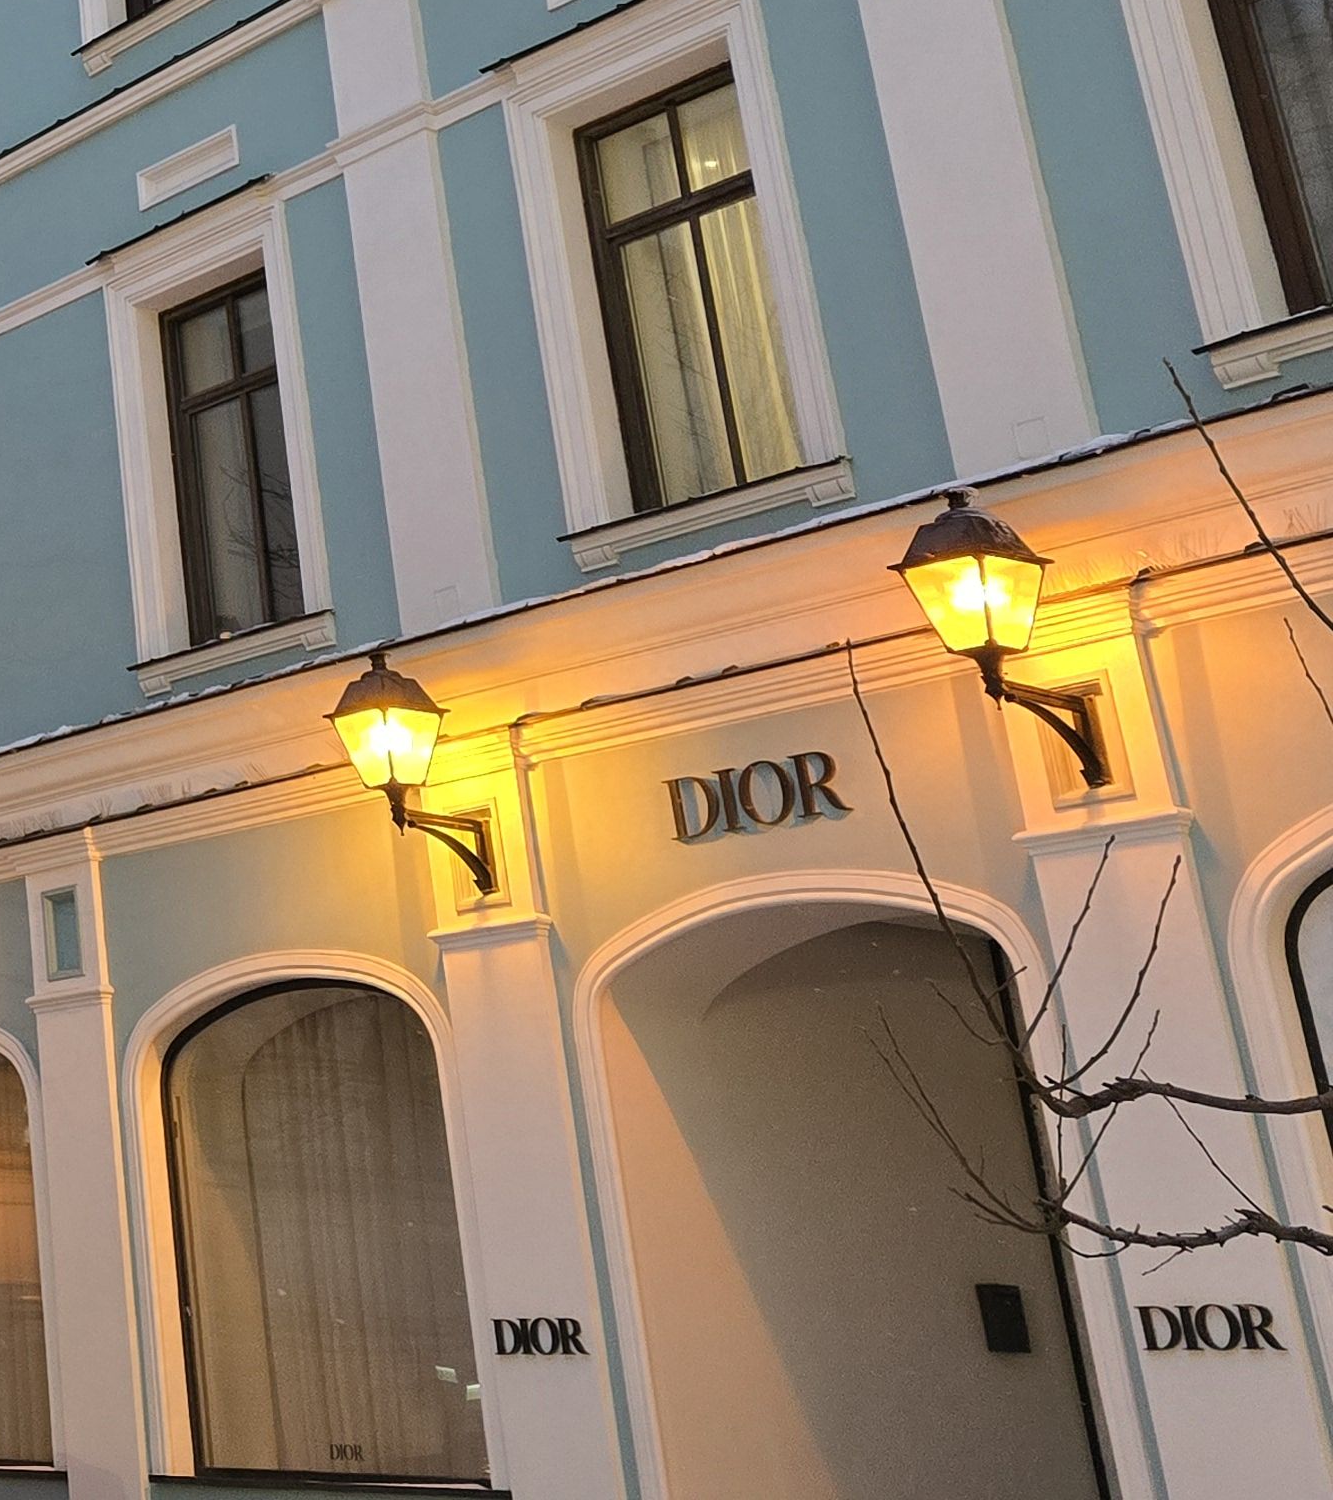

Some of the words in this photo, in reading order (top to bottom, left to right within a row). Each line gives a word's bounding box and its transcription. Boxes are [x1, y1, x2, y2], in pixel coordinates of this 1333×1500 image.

[661, 751, 855, 842] DIOR
[491, 1316, 590, 1356] DIOR
[1134, 1303, 1288, 1351] DIOR
[330, 1443, 364, 1461] DIOR
